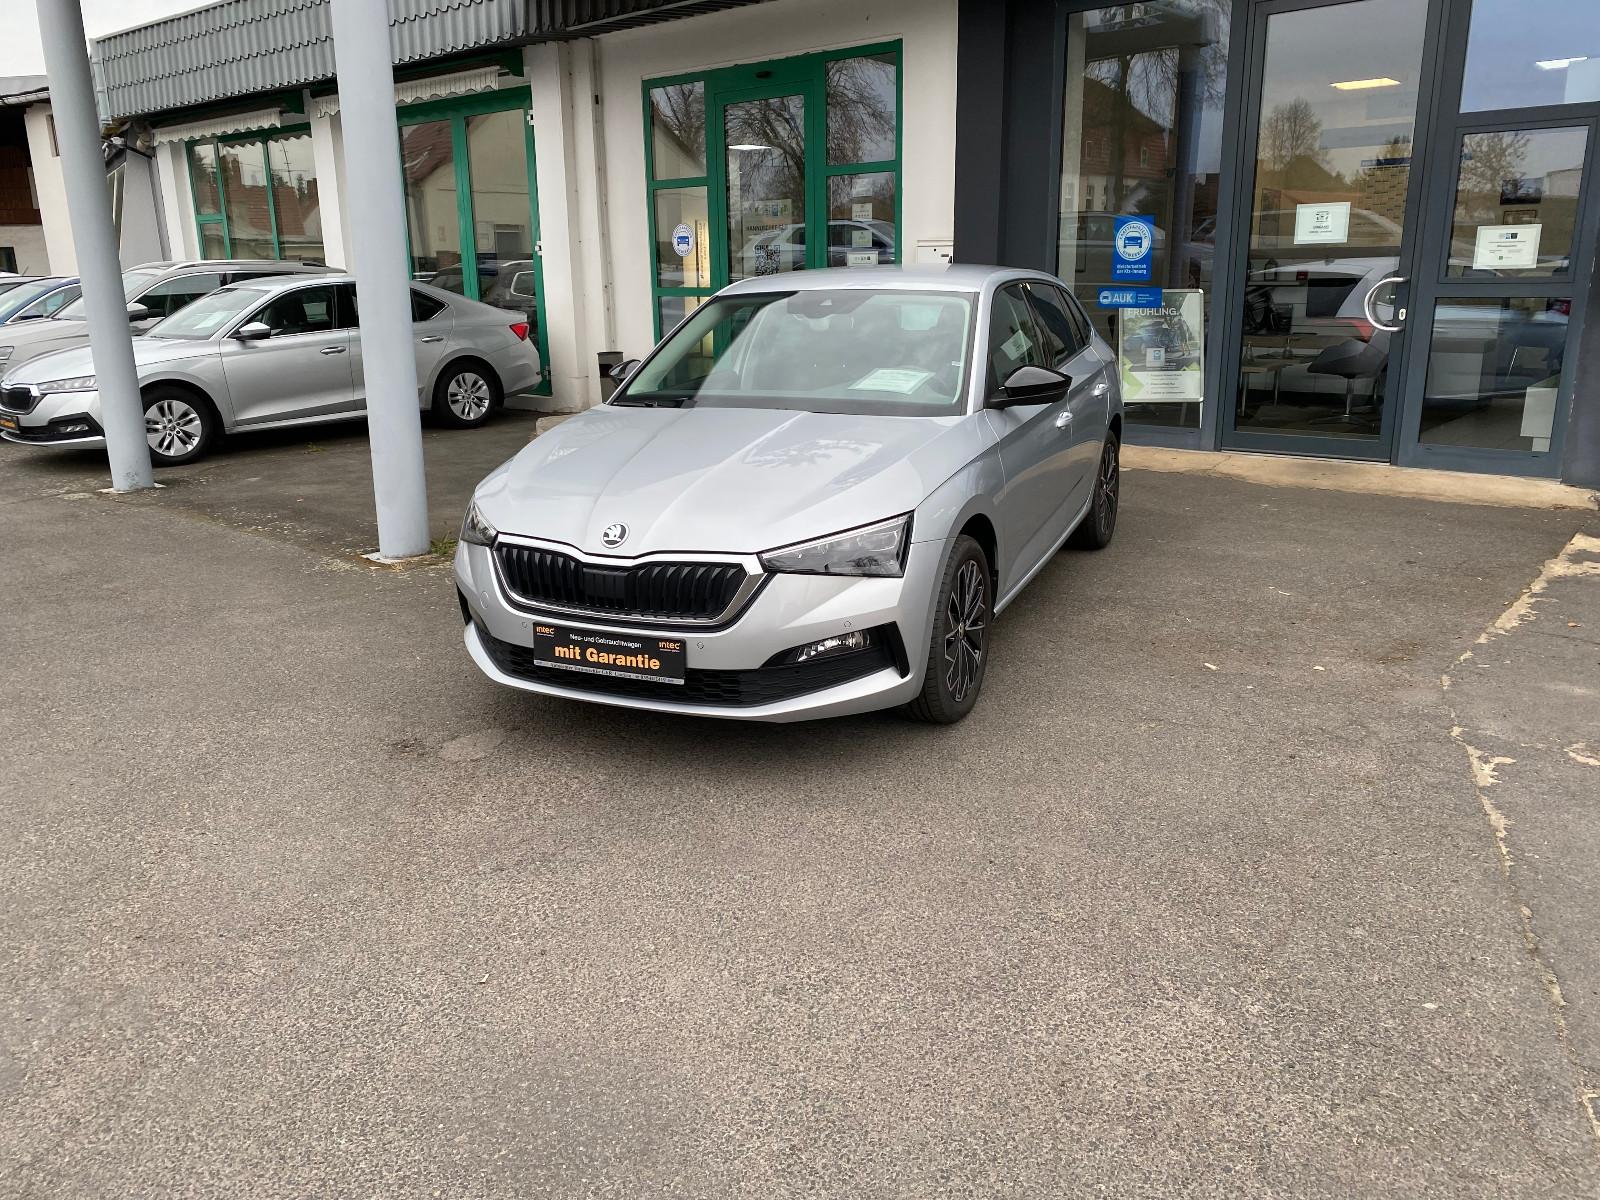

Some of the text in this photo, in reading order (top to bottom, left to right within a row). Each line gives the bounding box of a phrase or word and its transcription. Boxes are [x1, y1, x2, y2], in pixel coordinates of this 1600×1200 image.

[1113, 293, 1133, 303] AUK
[536, 625, 554, 635] intec
[569, 633, 642, 649] Neu- und Gebrauchtwagen
[658, 641, 681, 650] intec
[554, 645, 581, 660] mit
[585, 648, 661, 671] Garantie
